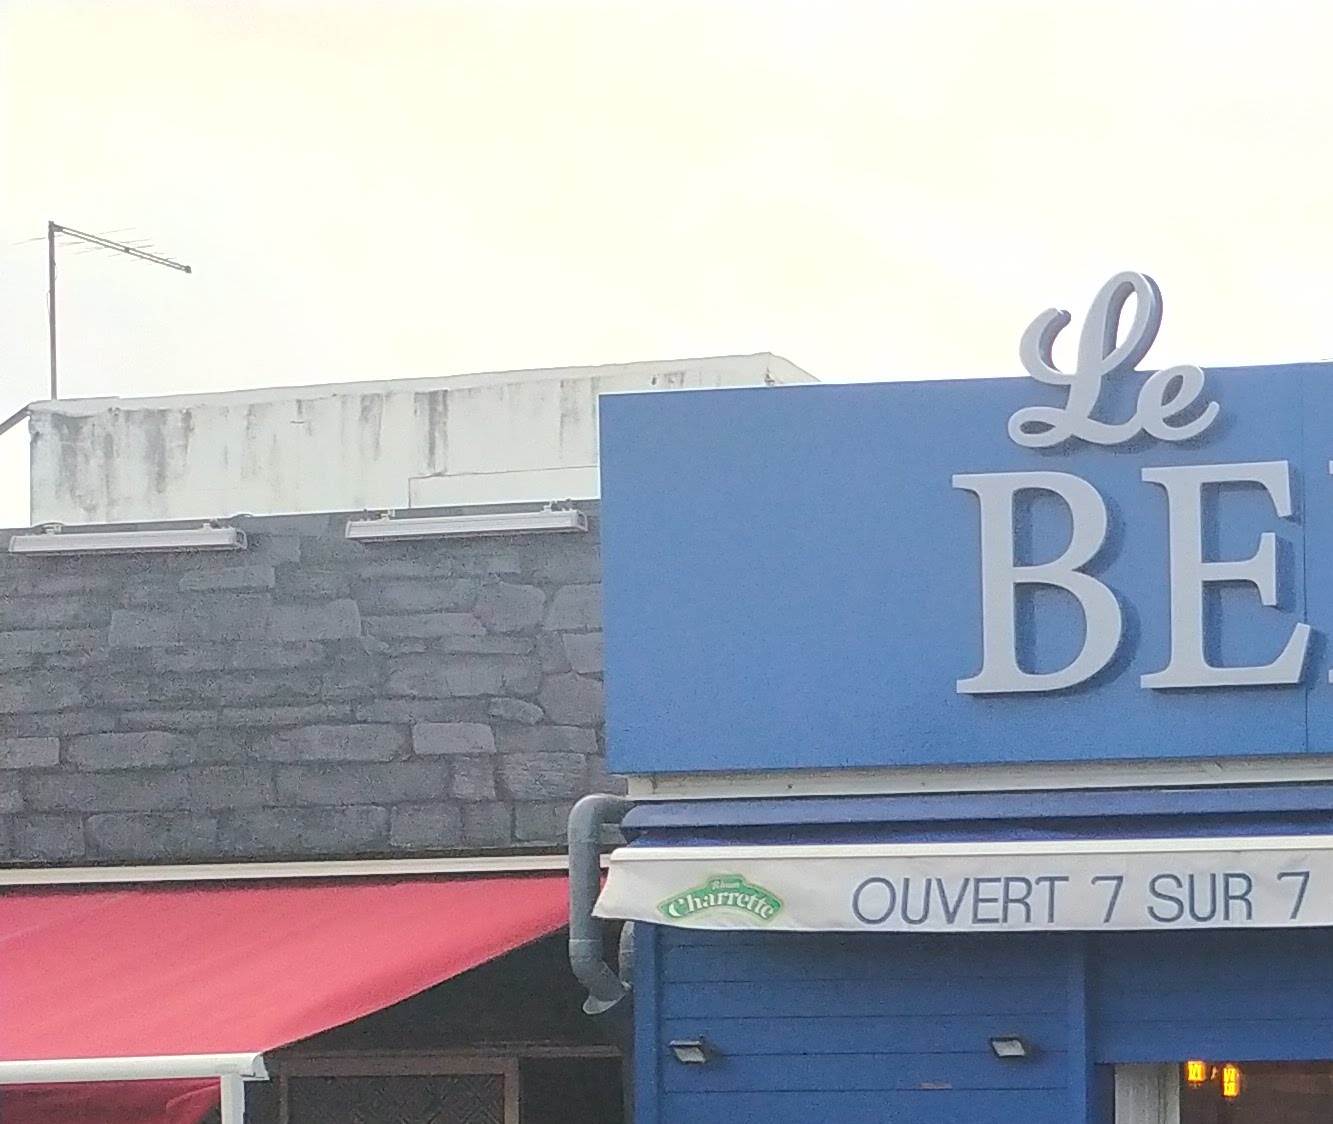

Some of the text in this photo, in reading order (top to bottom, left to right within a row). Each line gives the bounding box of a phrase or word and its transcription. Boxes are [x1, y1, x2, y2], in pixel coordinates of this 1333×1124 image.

[1007, 269, 1222, 450] Le
[667, 890, 775, 920] Charrette
[851, 874, 1070, 926] OUVERT
[1090, 875, 1124, 925] 7
[1146, 872, 1254, 925] SUR
[1276, 870, 1310, 921] 7
